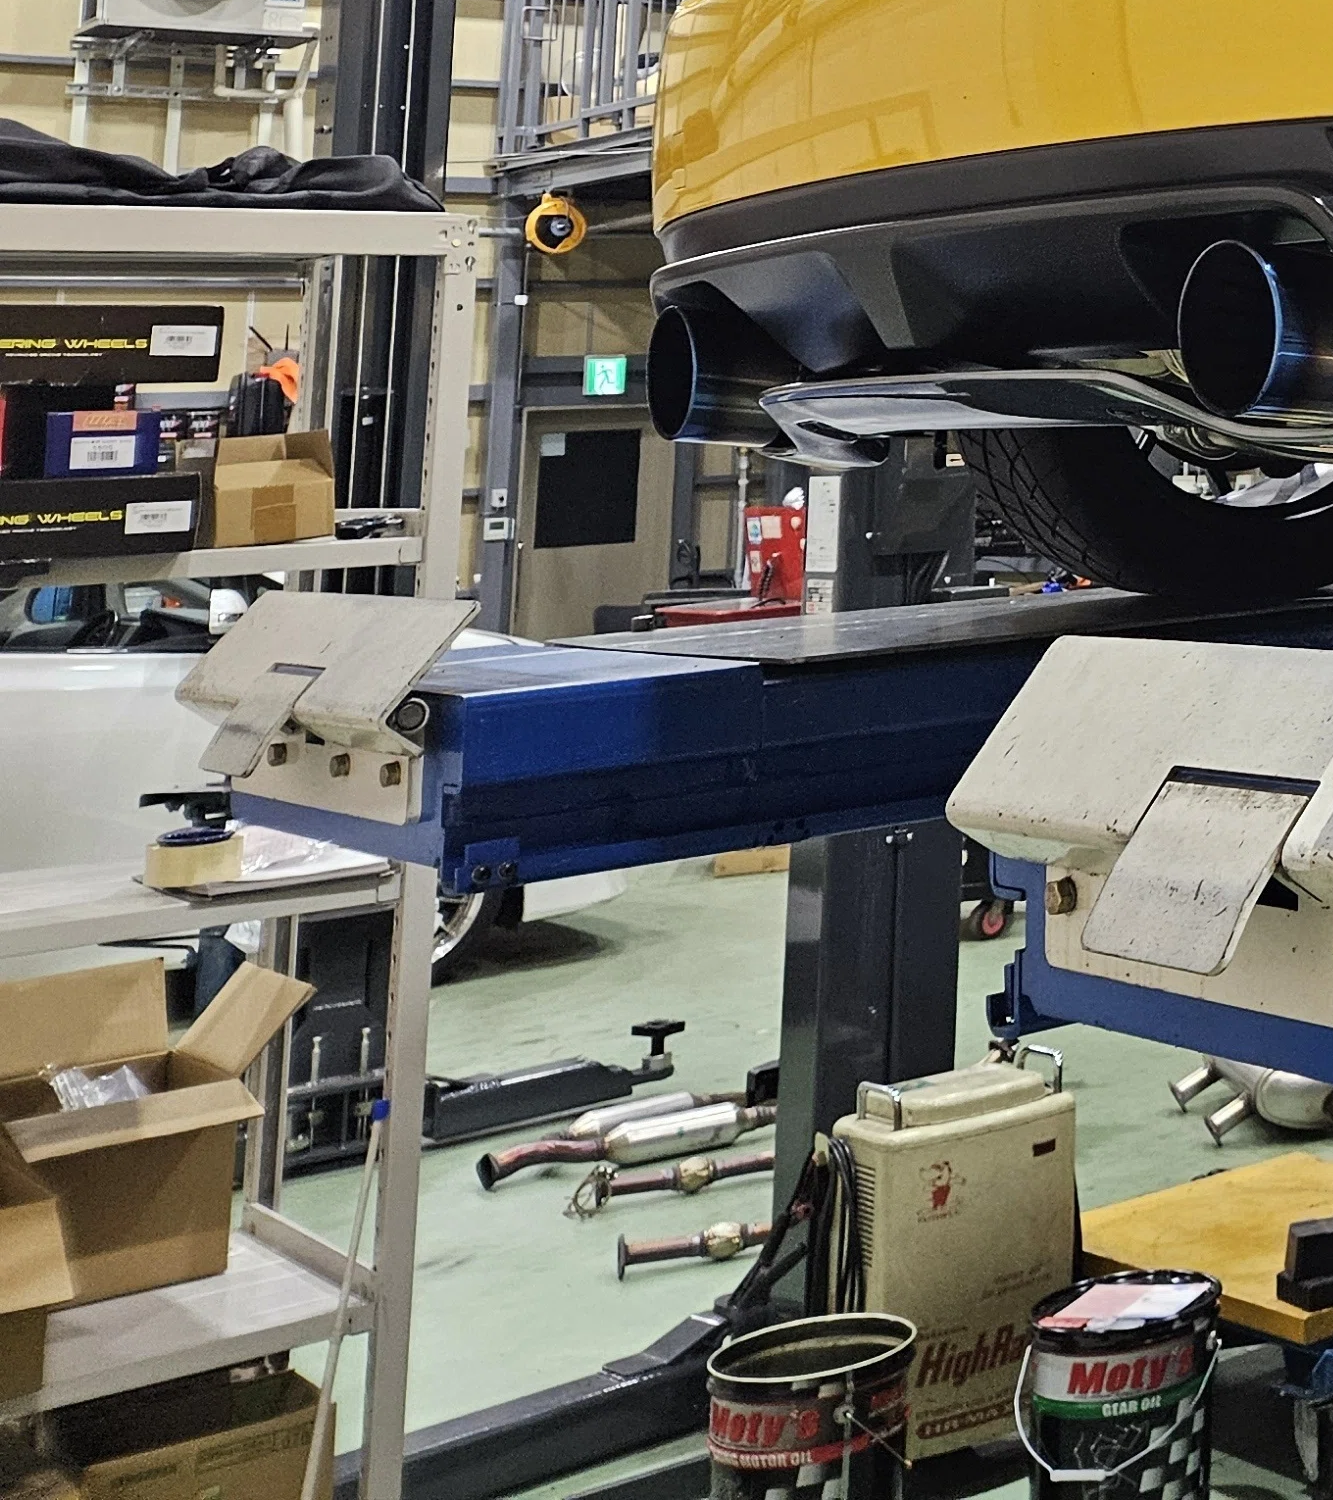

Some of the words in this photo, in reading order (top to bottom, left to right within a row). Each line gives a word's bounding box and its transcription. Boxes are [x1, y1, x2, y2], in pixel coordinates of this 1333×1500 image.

[63, 338, 148, 349] WHEELS
[37, 509, 123, 524] WHEELS
[914, 1322, 1028, 1389] HighRa
[1066, 1345, 1196, 1395] Moty's
[1101, 1399, 1138, 1418] GEAR
[1140, 1394, 1162, 1412] OIL
[710, 1403, 821, 1449] Moty's
[738, 1453, 788, 1469] MOTOR
[789, 1449, 813, 1467] OIL
